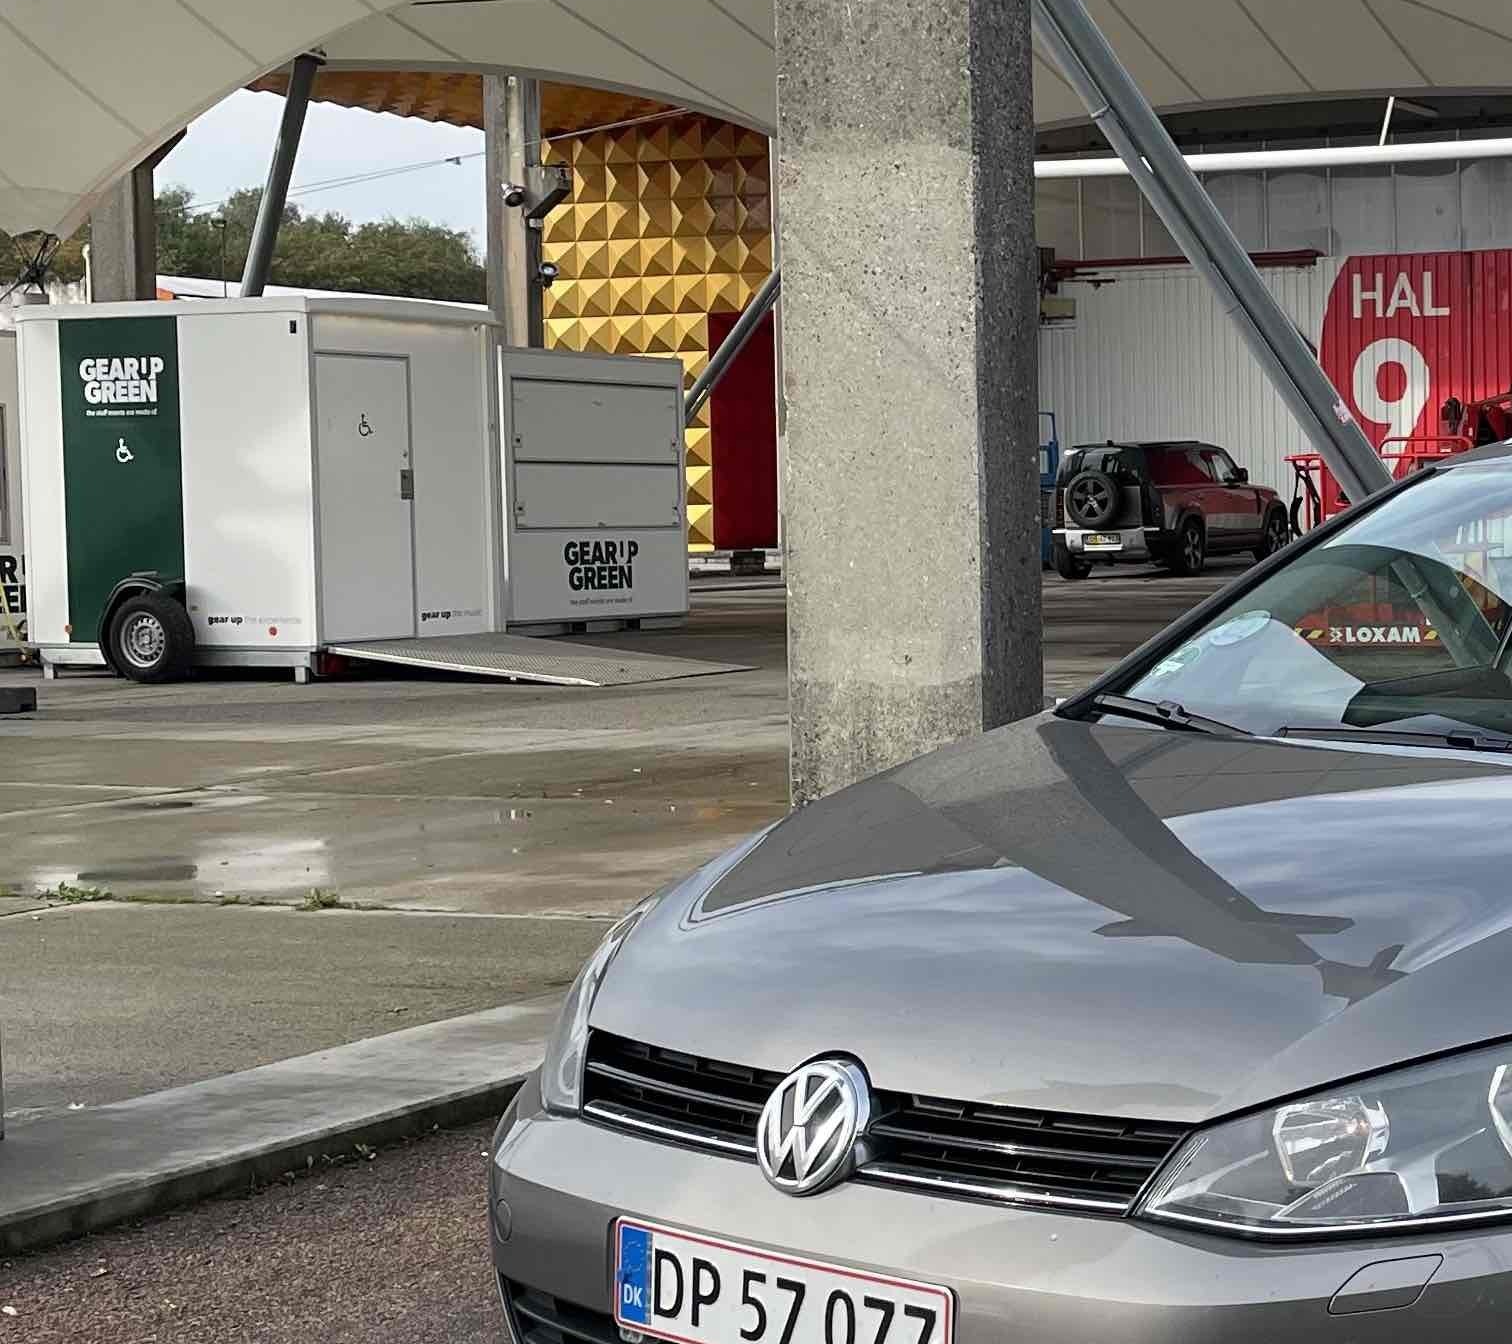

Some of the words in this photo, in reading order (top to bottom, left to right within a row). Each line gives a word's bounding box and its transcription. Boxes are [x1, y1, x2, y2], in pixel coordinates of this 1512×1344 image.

[1353, 271, 1450, 318] HAL
[84, 379, 158, 404] GREEN
[1353, 337, 1430, 468] 9
[568, 565, 633, 591] GREEN
[207, 616, 229, 626] gear
[230, 616, 244, 626] up
[1345, 626, 1421, 644] LOXAM
[623, 1283, 643, 1308] DK
[653, 1247, 721, 1328] DP
